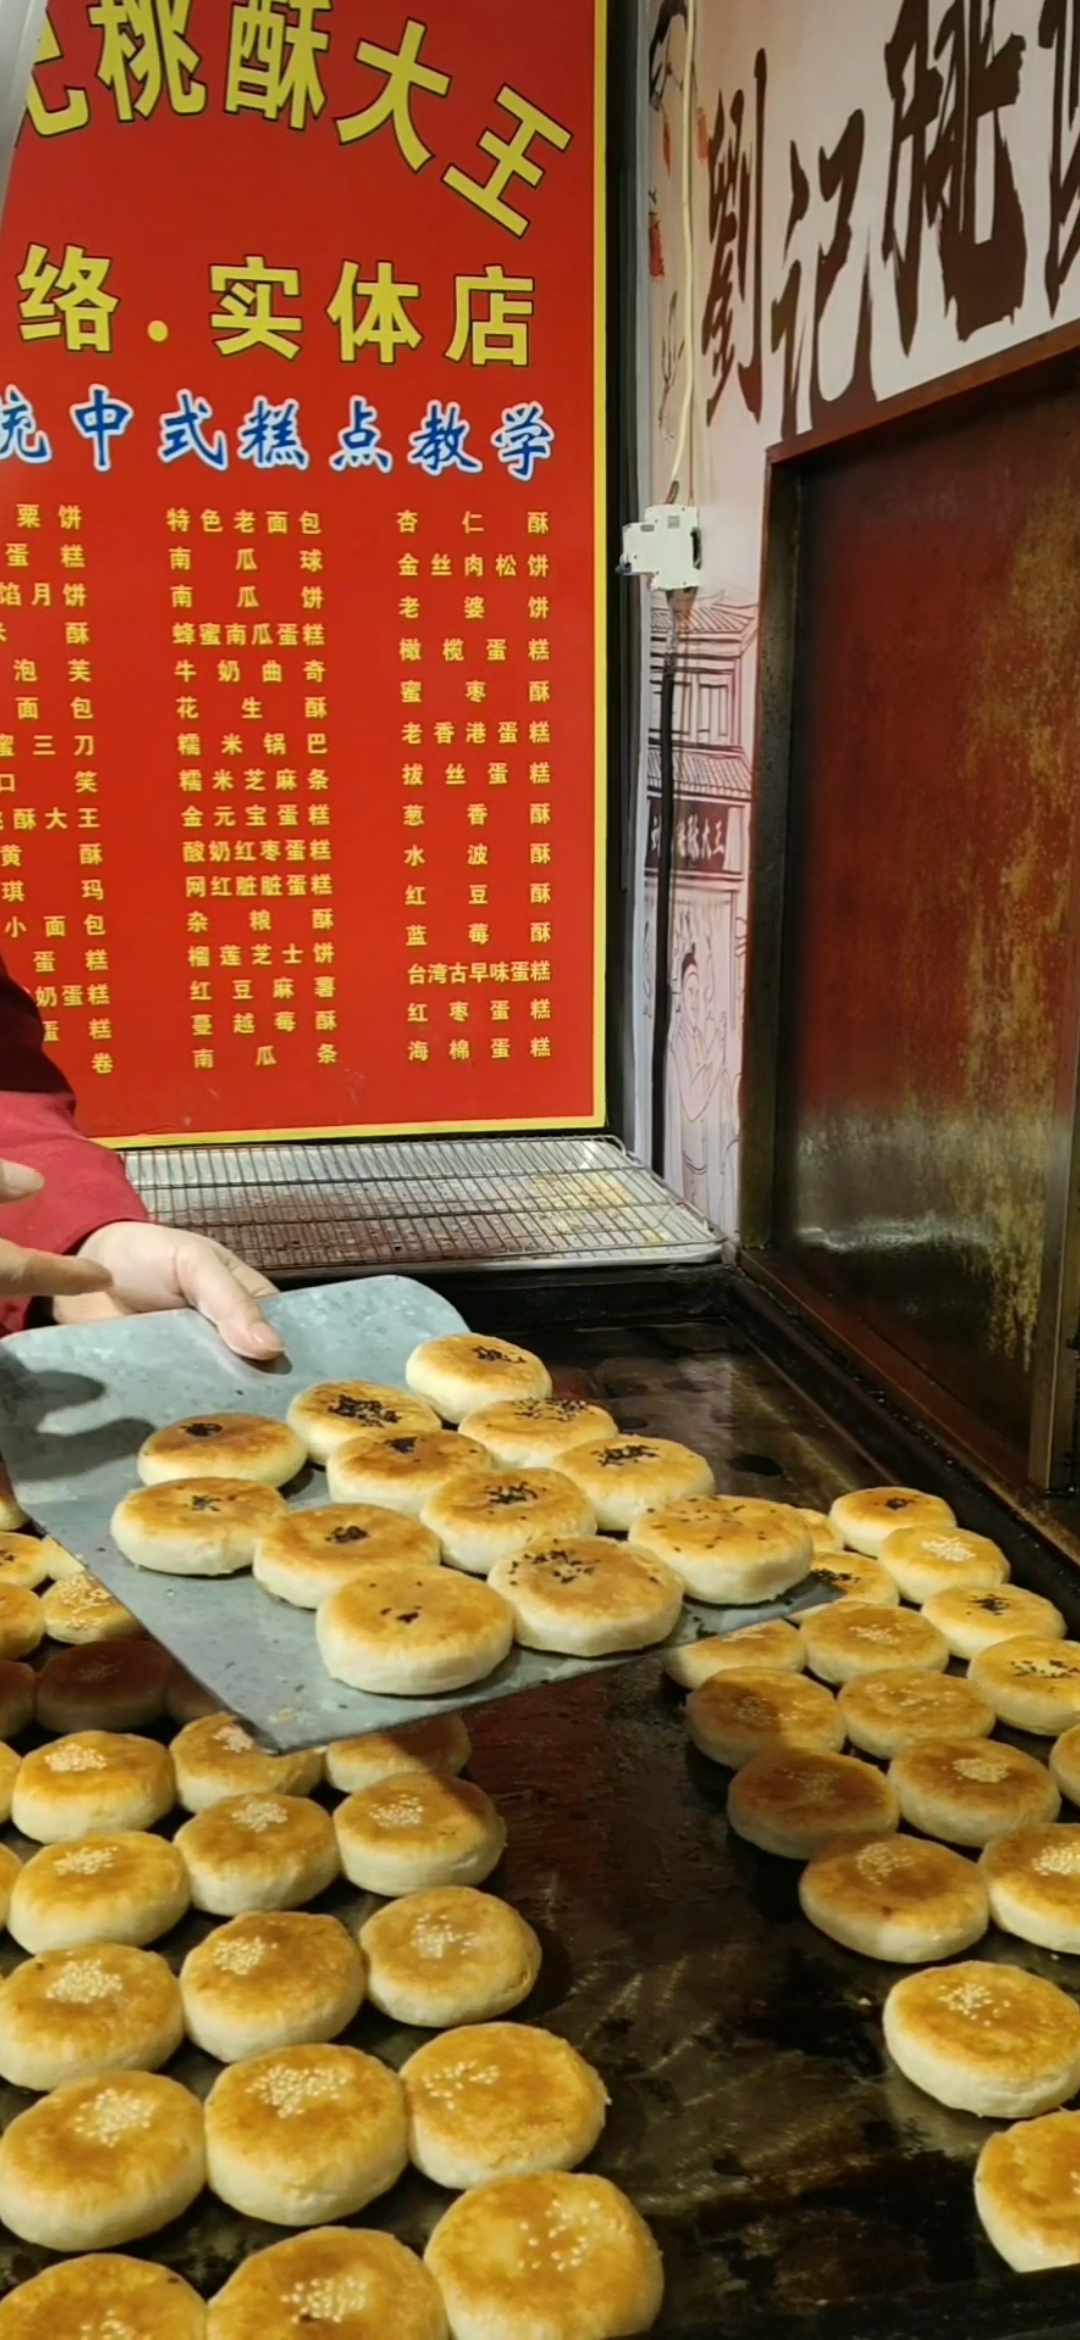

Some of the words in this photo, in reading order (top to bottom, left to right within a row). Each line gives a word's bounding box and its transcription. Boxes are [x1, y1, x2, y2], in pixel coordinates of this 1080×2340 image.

[167, 508, 320, 534] 特色老面包
[398, 510, 548, 534] 杏仁酥
[170, 547, 322, 572] 南瓜球
[399, 553, 548, 577] 金丝肉松饼
[171, 585, 323, 609] 南瓜饼
[400, 596, 549, 618] 老婆饼
[0, 622, 89, 644] 酥
[173, 623, 324, 645] 蜂蜜南瓜蛋糕
[14, 659, 90, 682] 泡芙
[175, 660, 325, 682] 牛奶曲奇
[401, 680, 550, 702] 蜜枣酥
[17, 697, 93, 719] 面包
[177, 697, 327, 718] 花生酥
[178, 733, 327, 755] 糯米锅巴
[402, 721, 550, 744] 老香港蛋糕
[180, 769, 328, 791] 糯米芝麻条
[403, 762, 550, 785] 拔丝蛋糕
[0, 808, 99, 830] 酥大王
[182, 804, 329, 827] 金元宝蛋糕
[404, 803, 550, 826] 葱香酥
[0, 843, 102, 866] 黄酥
[183, 840, 331, 862] 酸奶红枣蛋糕
[405, 843, 550, 866] 水波酥
[2, 880, 103, 902] 琪玛
[406, 883, 551, 905] 红豆酥
[6, 914, 105, 937] 小面包
[188, 908, 333, 933] 杂粮酥
[406, 922, 551, 946] 蓝莓酥
[34, 950, 108, 972] 蛋糕
[189, 942, 334, 967] 榴莲芝士饼
[408, 961, 550, 984] 台湾古早味蛋糕
[26, 984, 109, 1007] 奶蛋糕
[408, 999, 550, 1022] 红枣蛋糕
[194, 1044, 337, 1068] 南瓜条
[409, 1037, 550, 1061] 海棉蛋糕
[93, 1053, 113, 1073] 卷
